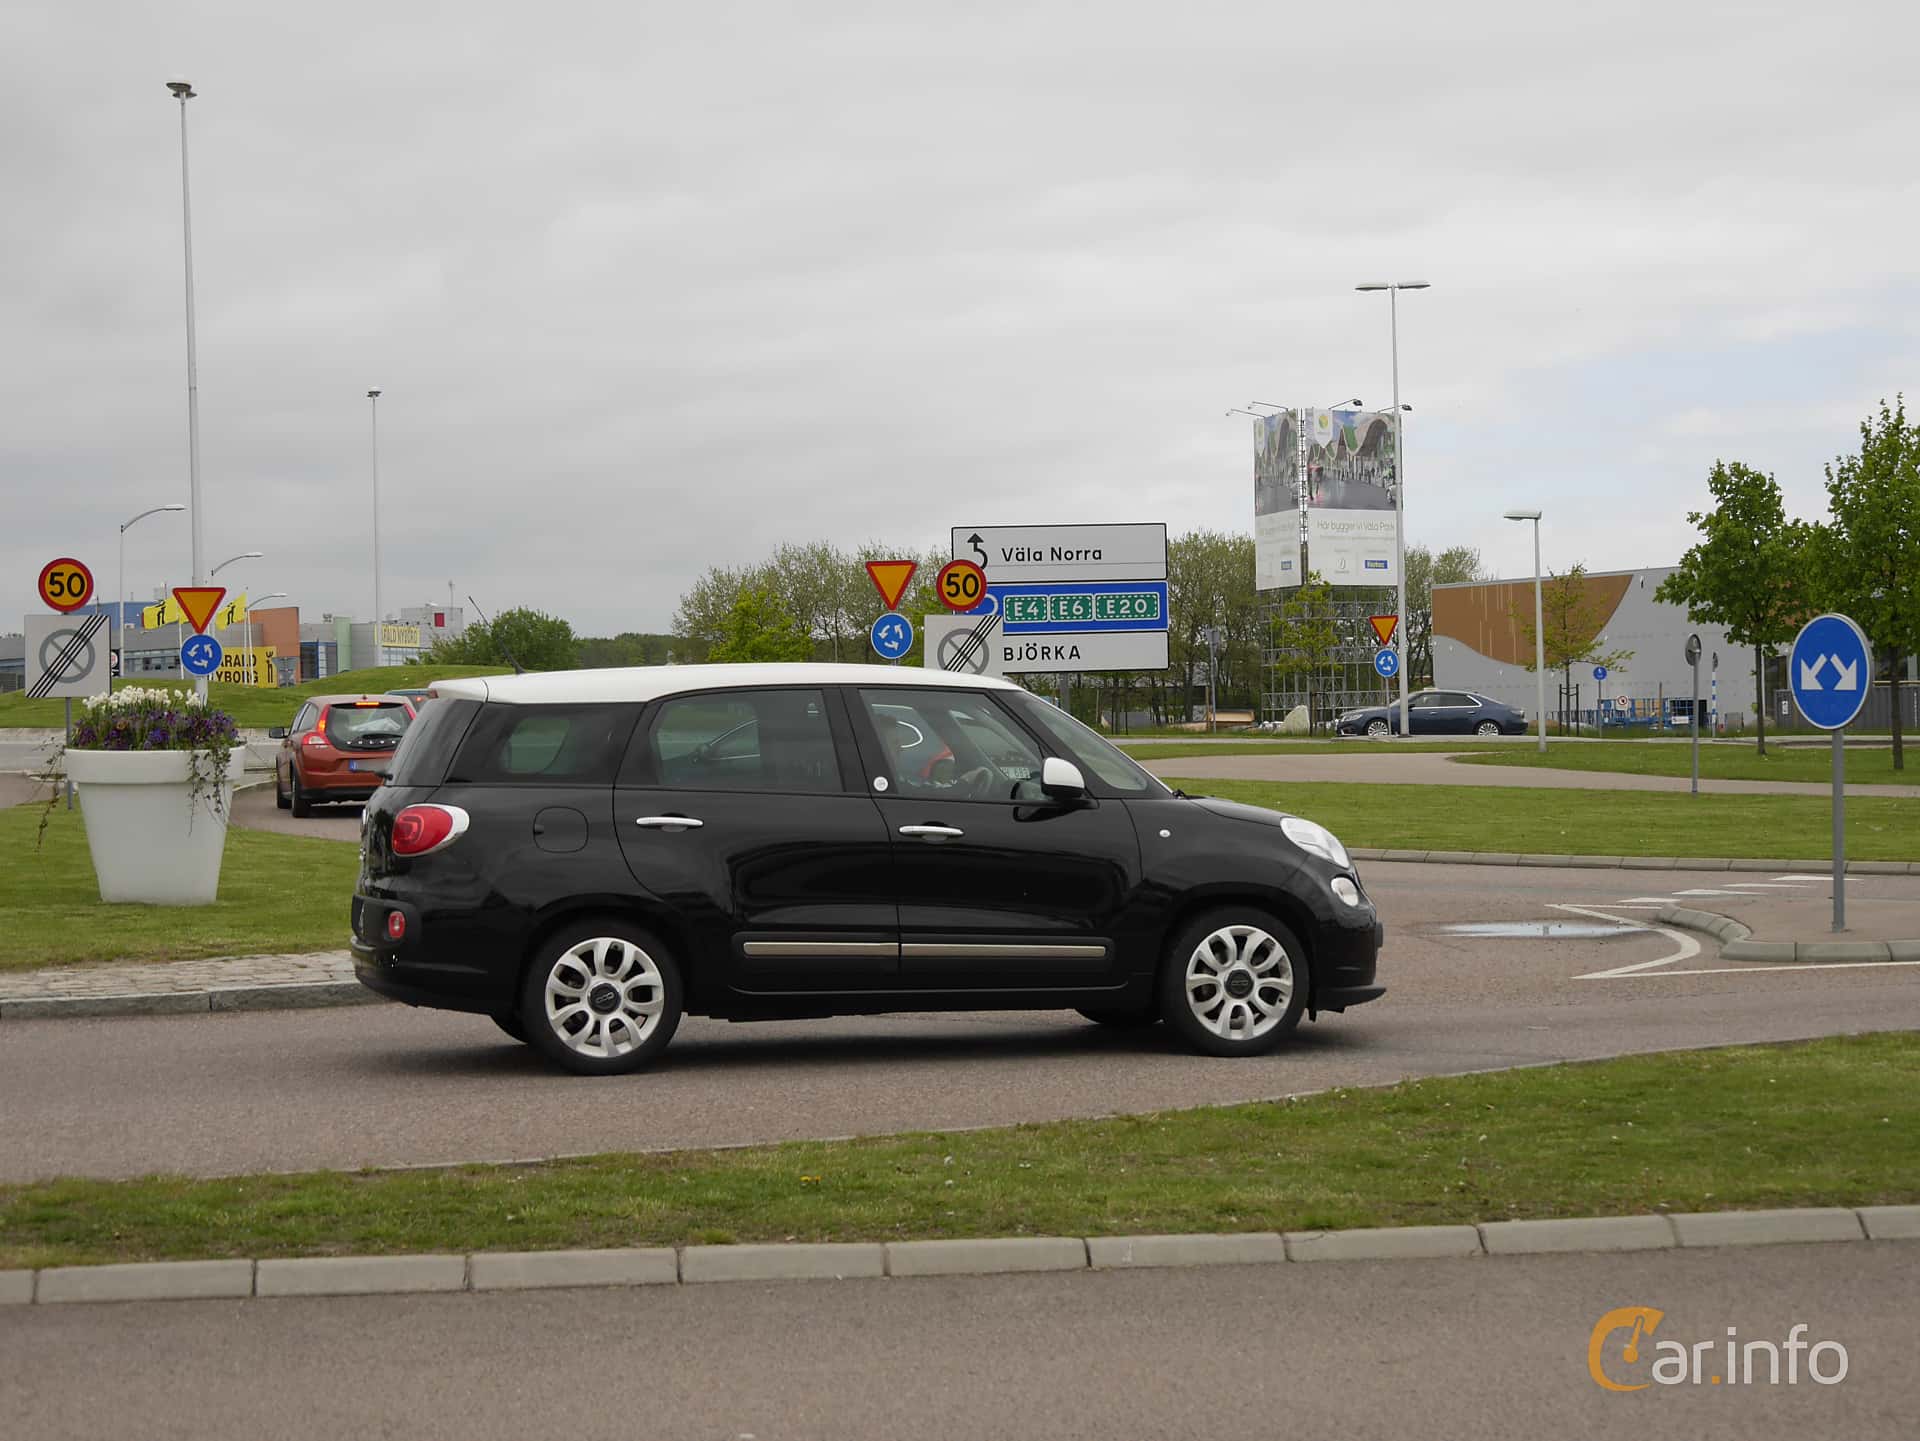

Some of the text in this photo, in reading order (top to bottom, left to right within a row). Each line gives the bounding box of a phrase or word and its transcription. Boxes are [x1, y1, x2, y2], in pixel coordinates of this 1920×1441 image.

[1002, 547, 1102, 562] Väla Norra
[49, 571, 86, 598] 50
[946, 573, 979, 598] 50
[1014, 598, 1148, 616] E4 E6 E20
[1003, 642, 1081, 661] BJÖRKA
